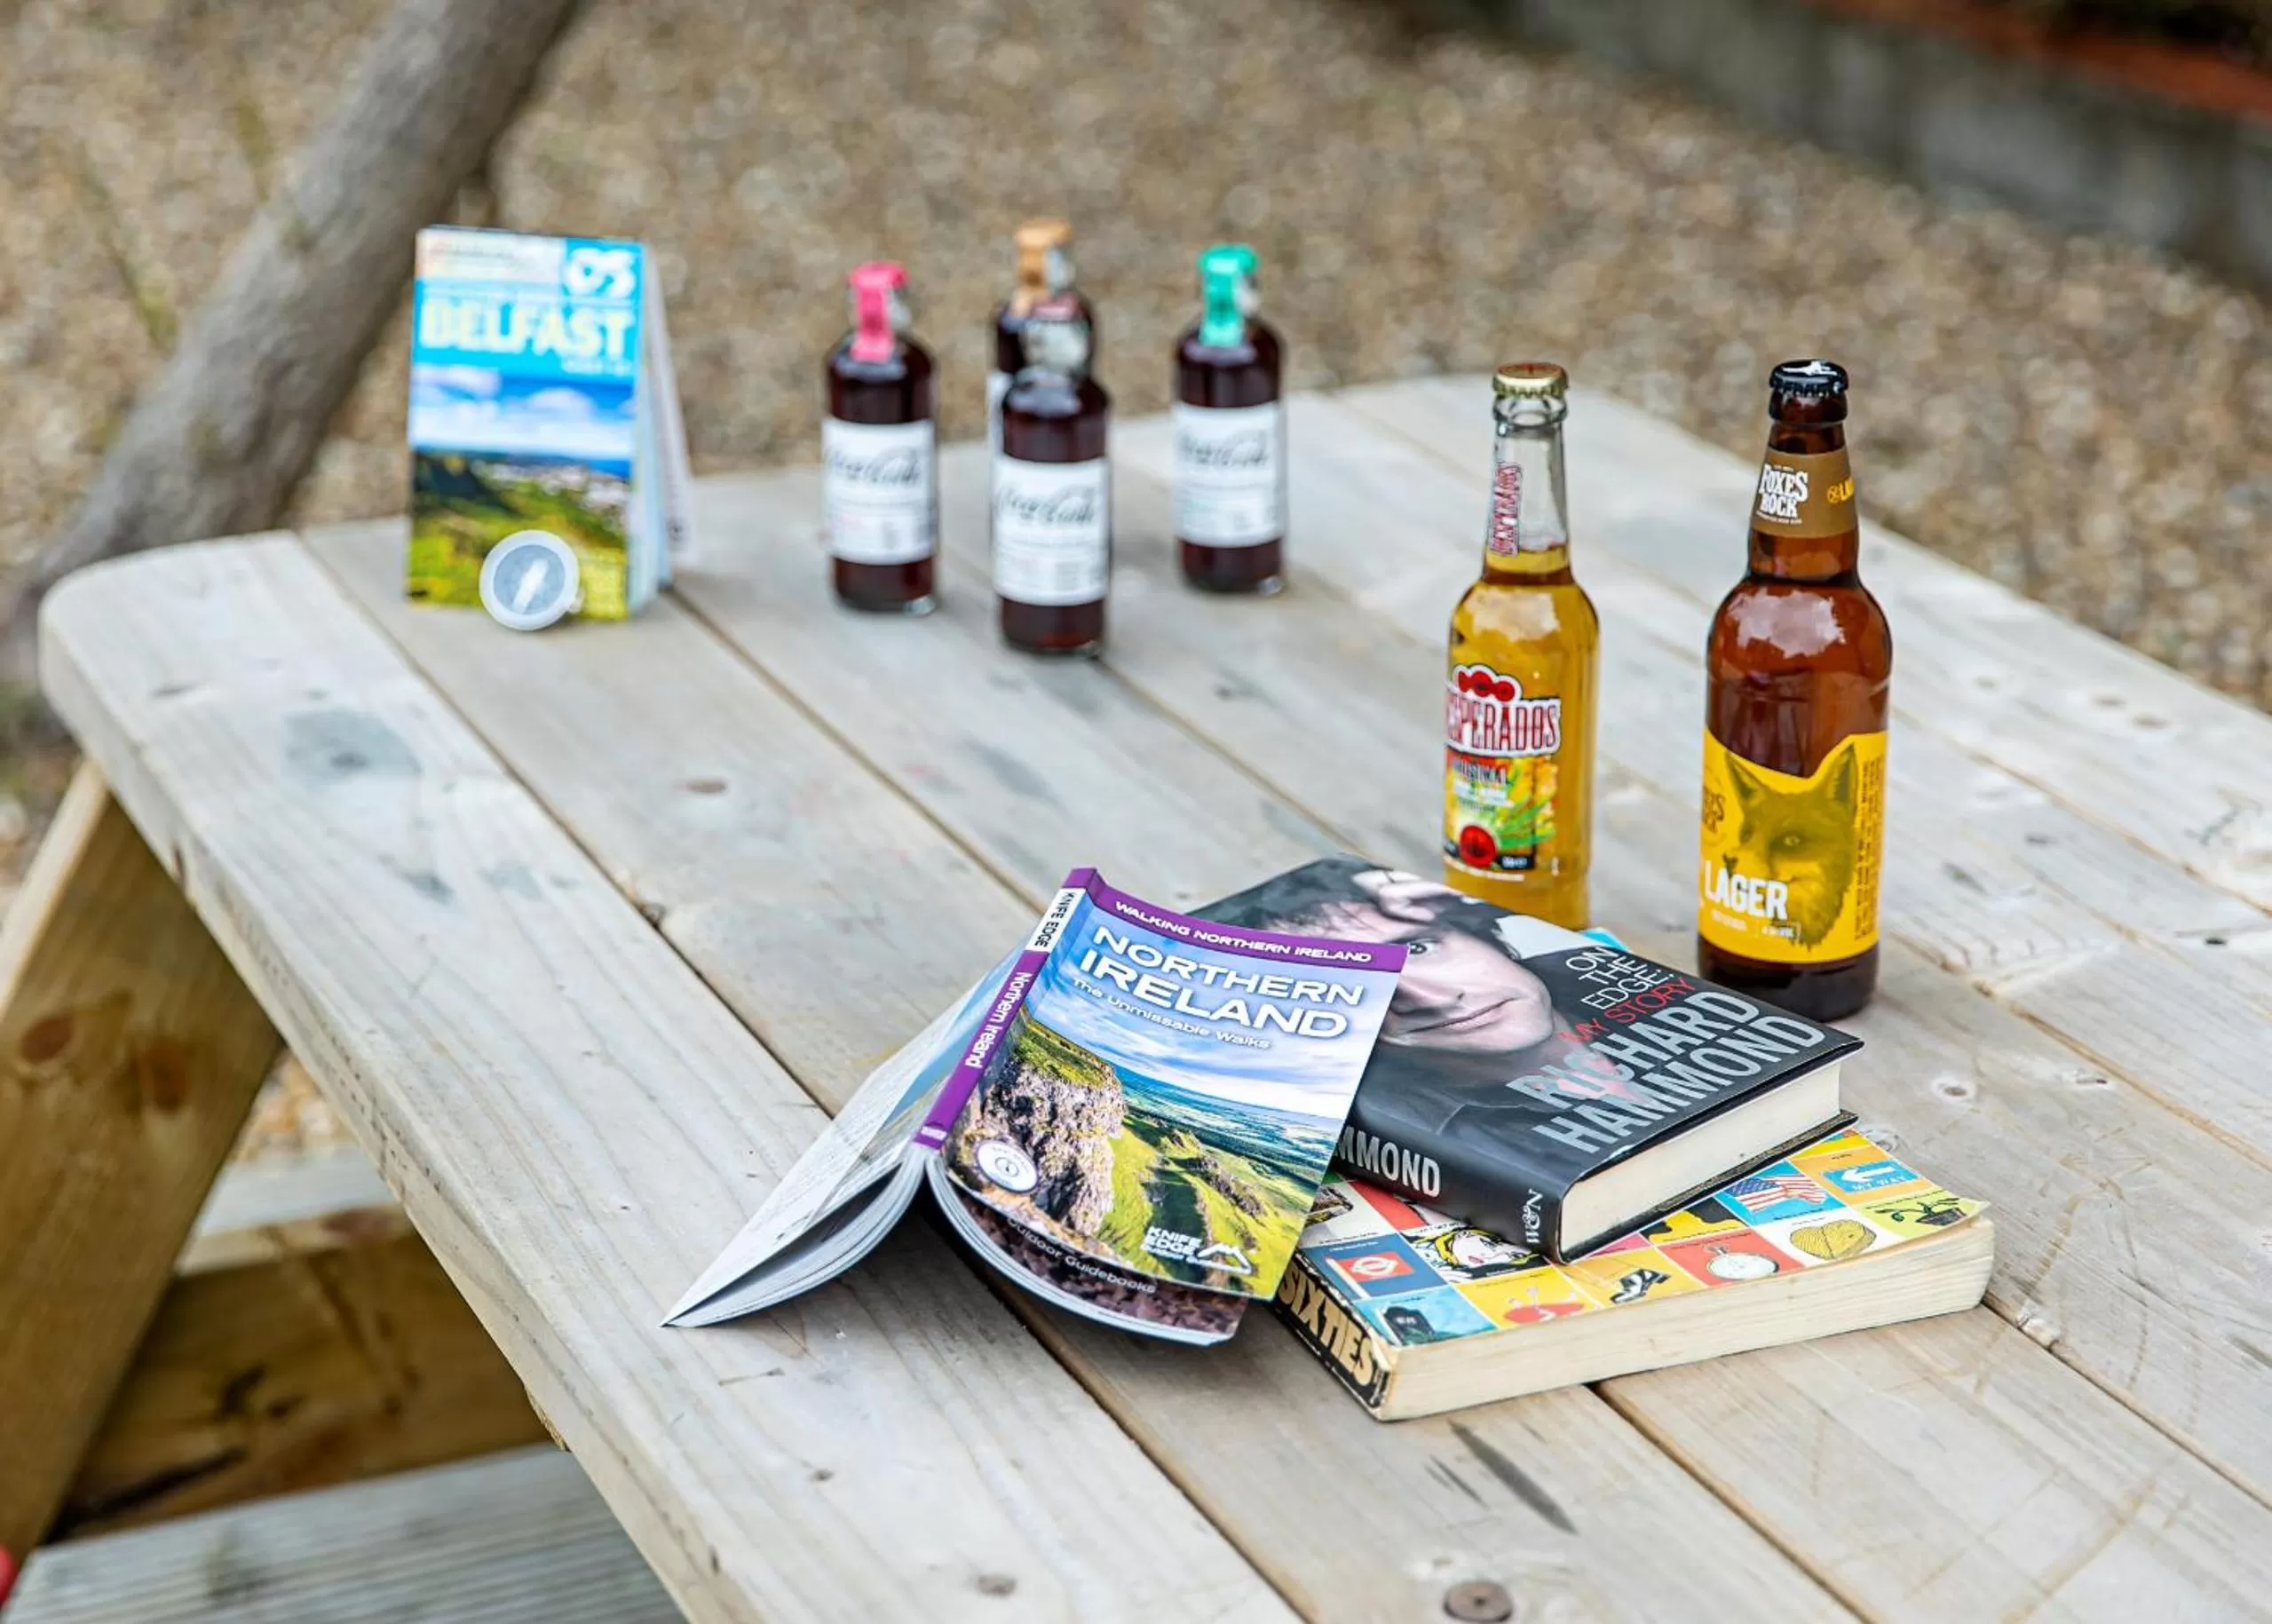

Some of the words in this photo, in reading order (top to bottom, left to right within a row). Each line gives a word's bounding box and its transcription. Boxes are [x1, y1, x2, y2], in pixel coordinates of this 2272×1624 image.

[1759, 463, 1809, 503] FOXES
[1760, 493, 1798, 519] ROCK
[1447, 695, 1556, 751] SPERADOS
[1051, 891, 1075, 920] KNIFE
[1705, 860, 1788, 920] LAGER
[1034, 920, 1059, 947] EDGE
[1115, 901, 1191, 936] WALKING
[1194, 931, 1291, 954] NORTHERN
[1294, 947, 1372, 963] IRELAND
[1565, 946, 1619, 970] ON
[1093, 926, 1364, 1006] NORTHERN
[1578, 955, 1644, 985] THE
[992, 971, 1033, 1024] Northern
[1073, 978, 1103, 998] The
[1108, 994, 1211, 1037] Unmissable
[1215, 1029, 1272, 1050] Walks
[1080, 948, 1348, 1039] IRELAND
[1556, 1018, 1610, 1043] MY
[1603, 978, 1697, 1024] STORY
[964, 1024, 1003, 1068] Ireland
[1507, 991, 1761, 1111] RICHARD
[1532, 1015, 1826, 1154] HAMMOND
[1335, 1125, 1440, 1198] MMOND
[1144, 1235, 1197, 1256] EDGE
[1147, 1225, 1202, 1248] KNIFE
[1065, 1255, 1157, 1294] Guidebooks
[1278, 1262, 1374, 1386] SIXTIES
